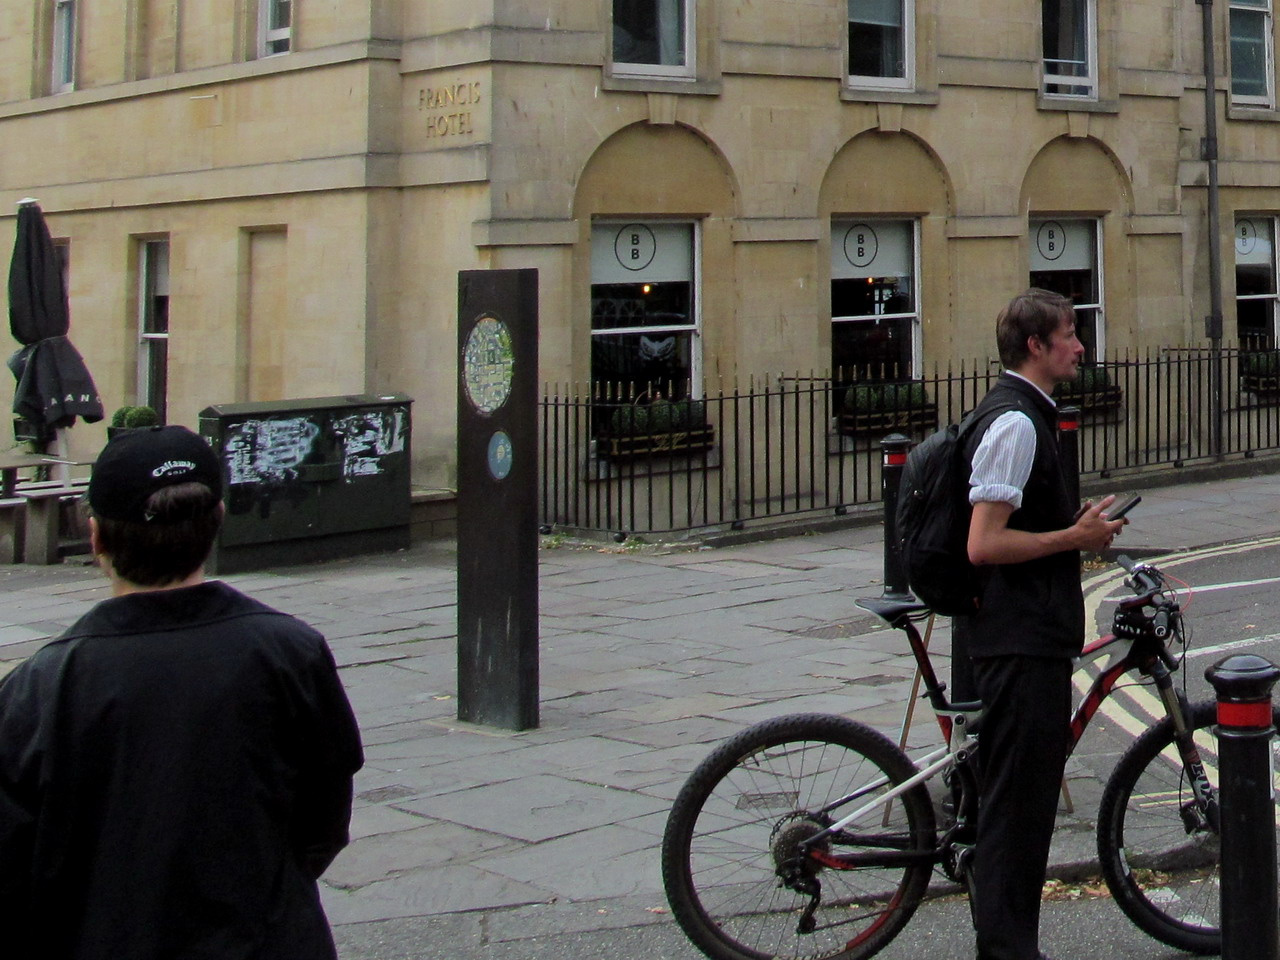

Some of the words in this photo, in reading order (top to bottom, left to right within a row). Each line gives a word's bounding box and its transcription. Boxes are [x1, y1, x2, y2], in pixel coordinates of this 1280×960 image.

[419, 82, 480, 110] FRANCIS
[426, 112, 473, 138] HOTEL
[631, 234, 640, 245] B
[857, 234, 865, 244] B
[631, 249, 640, 260] B
[857, 247, 865, 257] B
